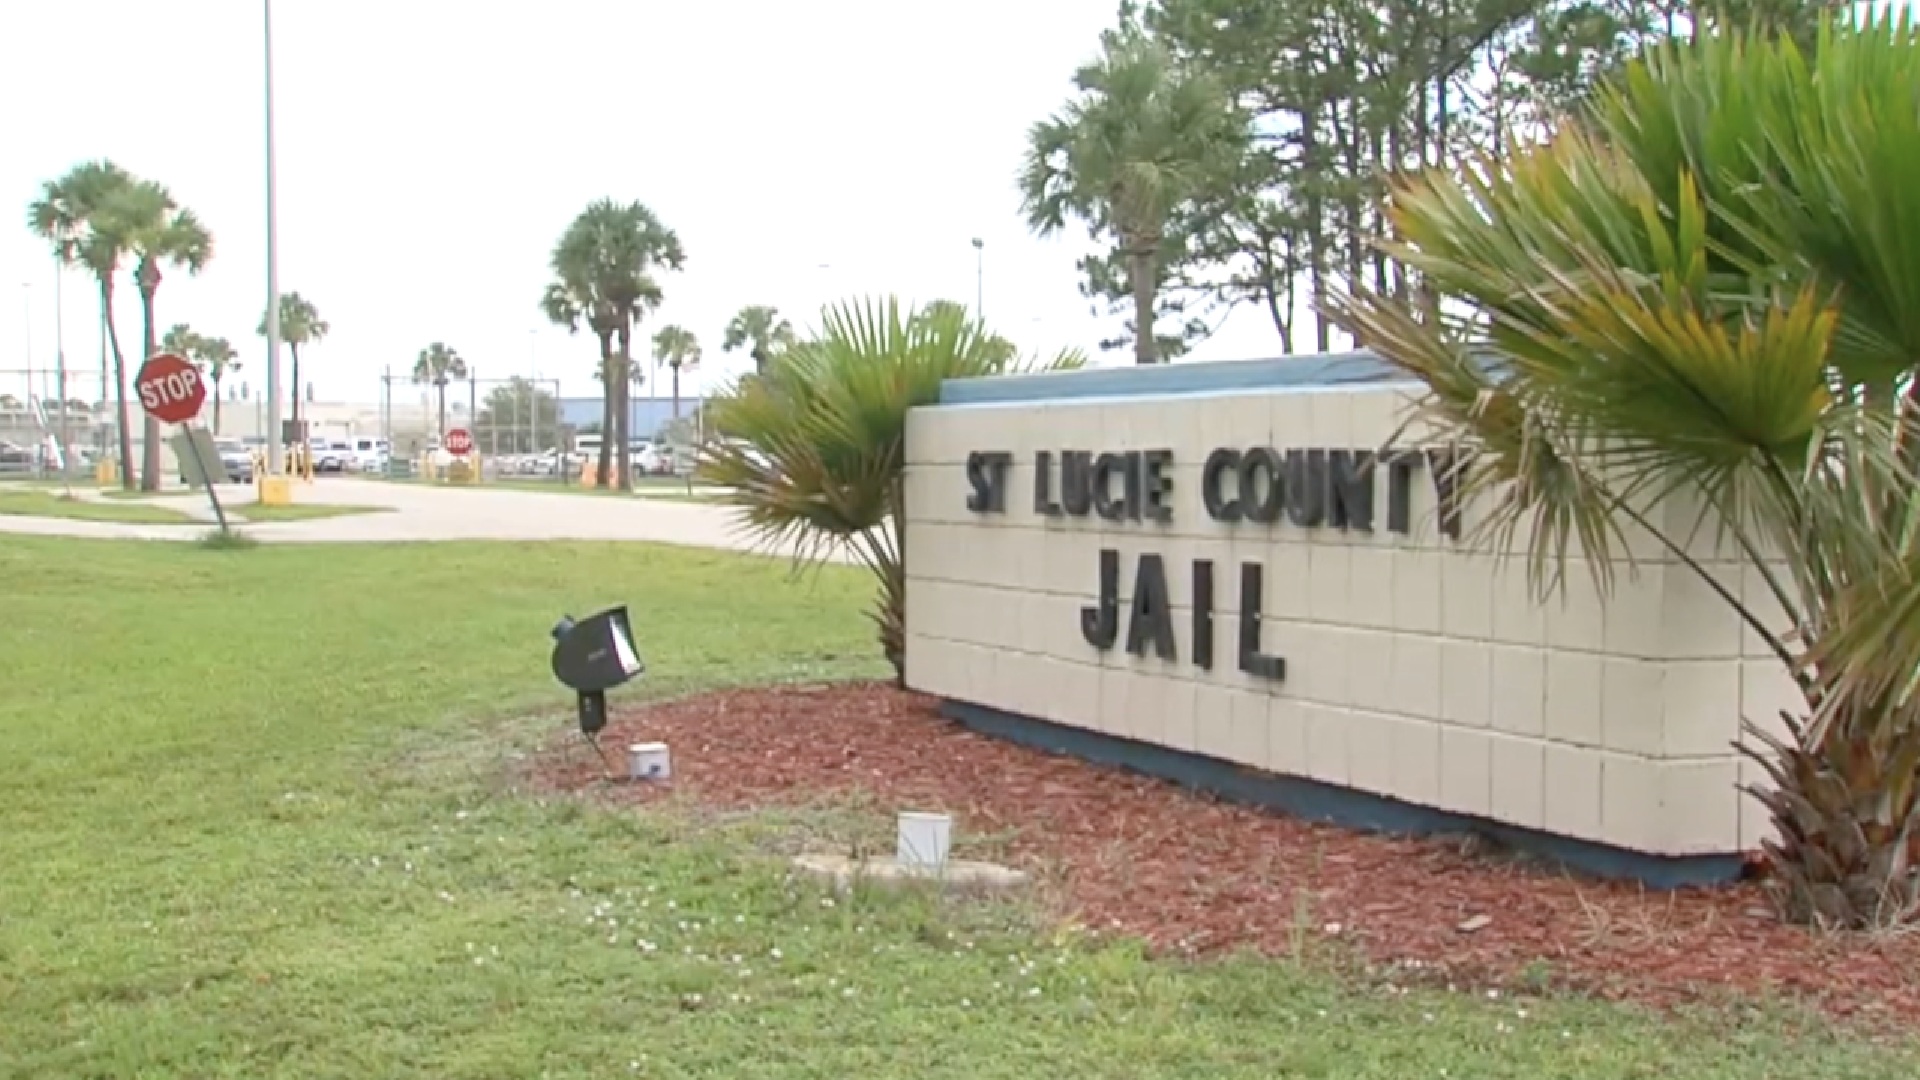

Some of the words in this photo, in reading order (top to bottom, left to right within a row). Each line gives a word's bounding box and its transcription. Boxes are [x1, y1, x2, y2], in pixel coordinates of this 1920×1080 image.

[140, 368, 197, 408] STOP
[446, 435, 470, 449] STOP
[966, 450, 1012, 515] ST
[1033, 449, 1174, 525] LUCIE
[1202, 446, 1475, 540] COUNTY
[1080, 548, 1286, 681] JAIL
